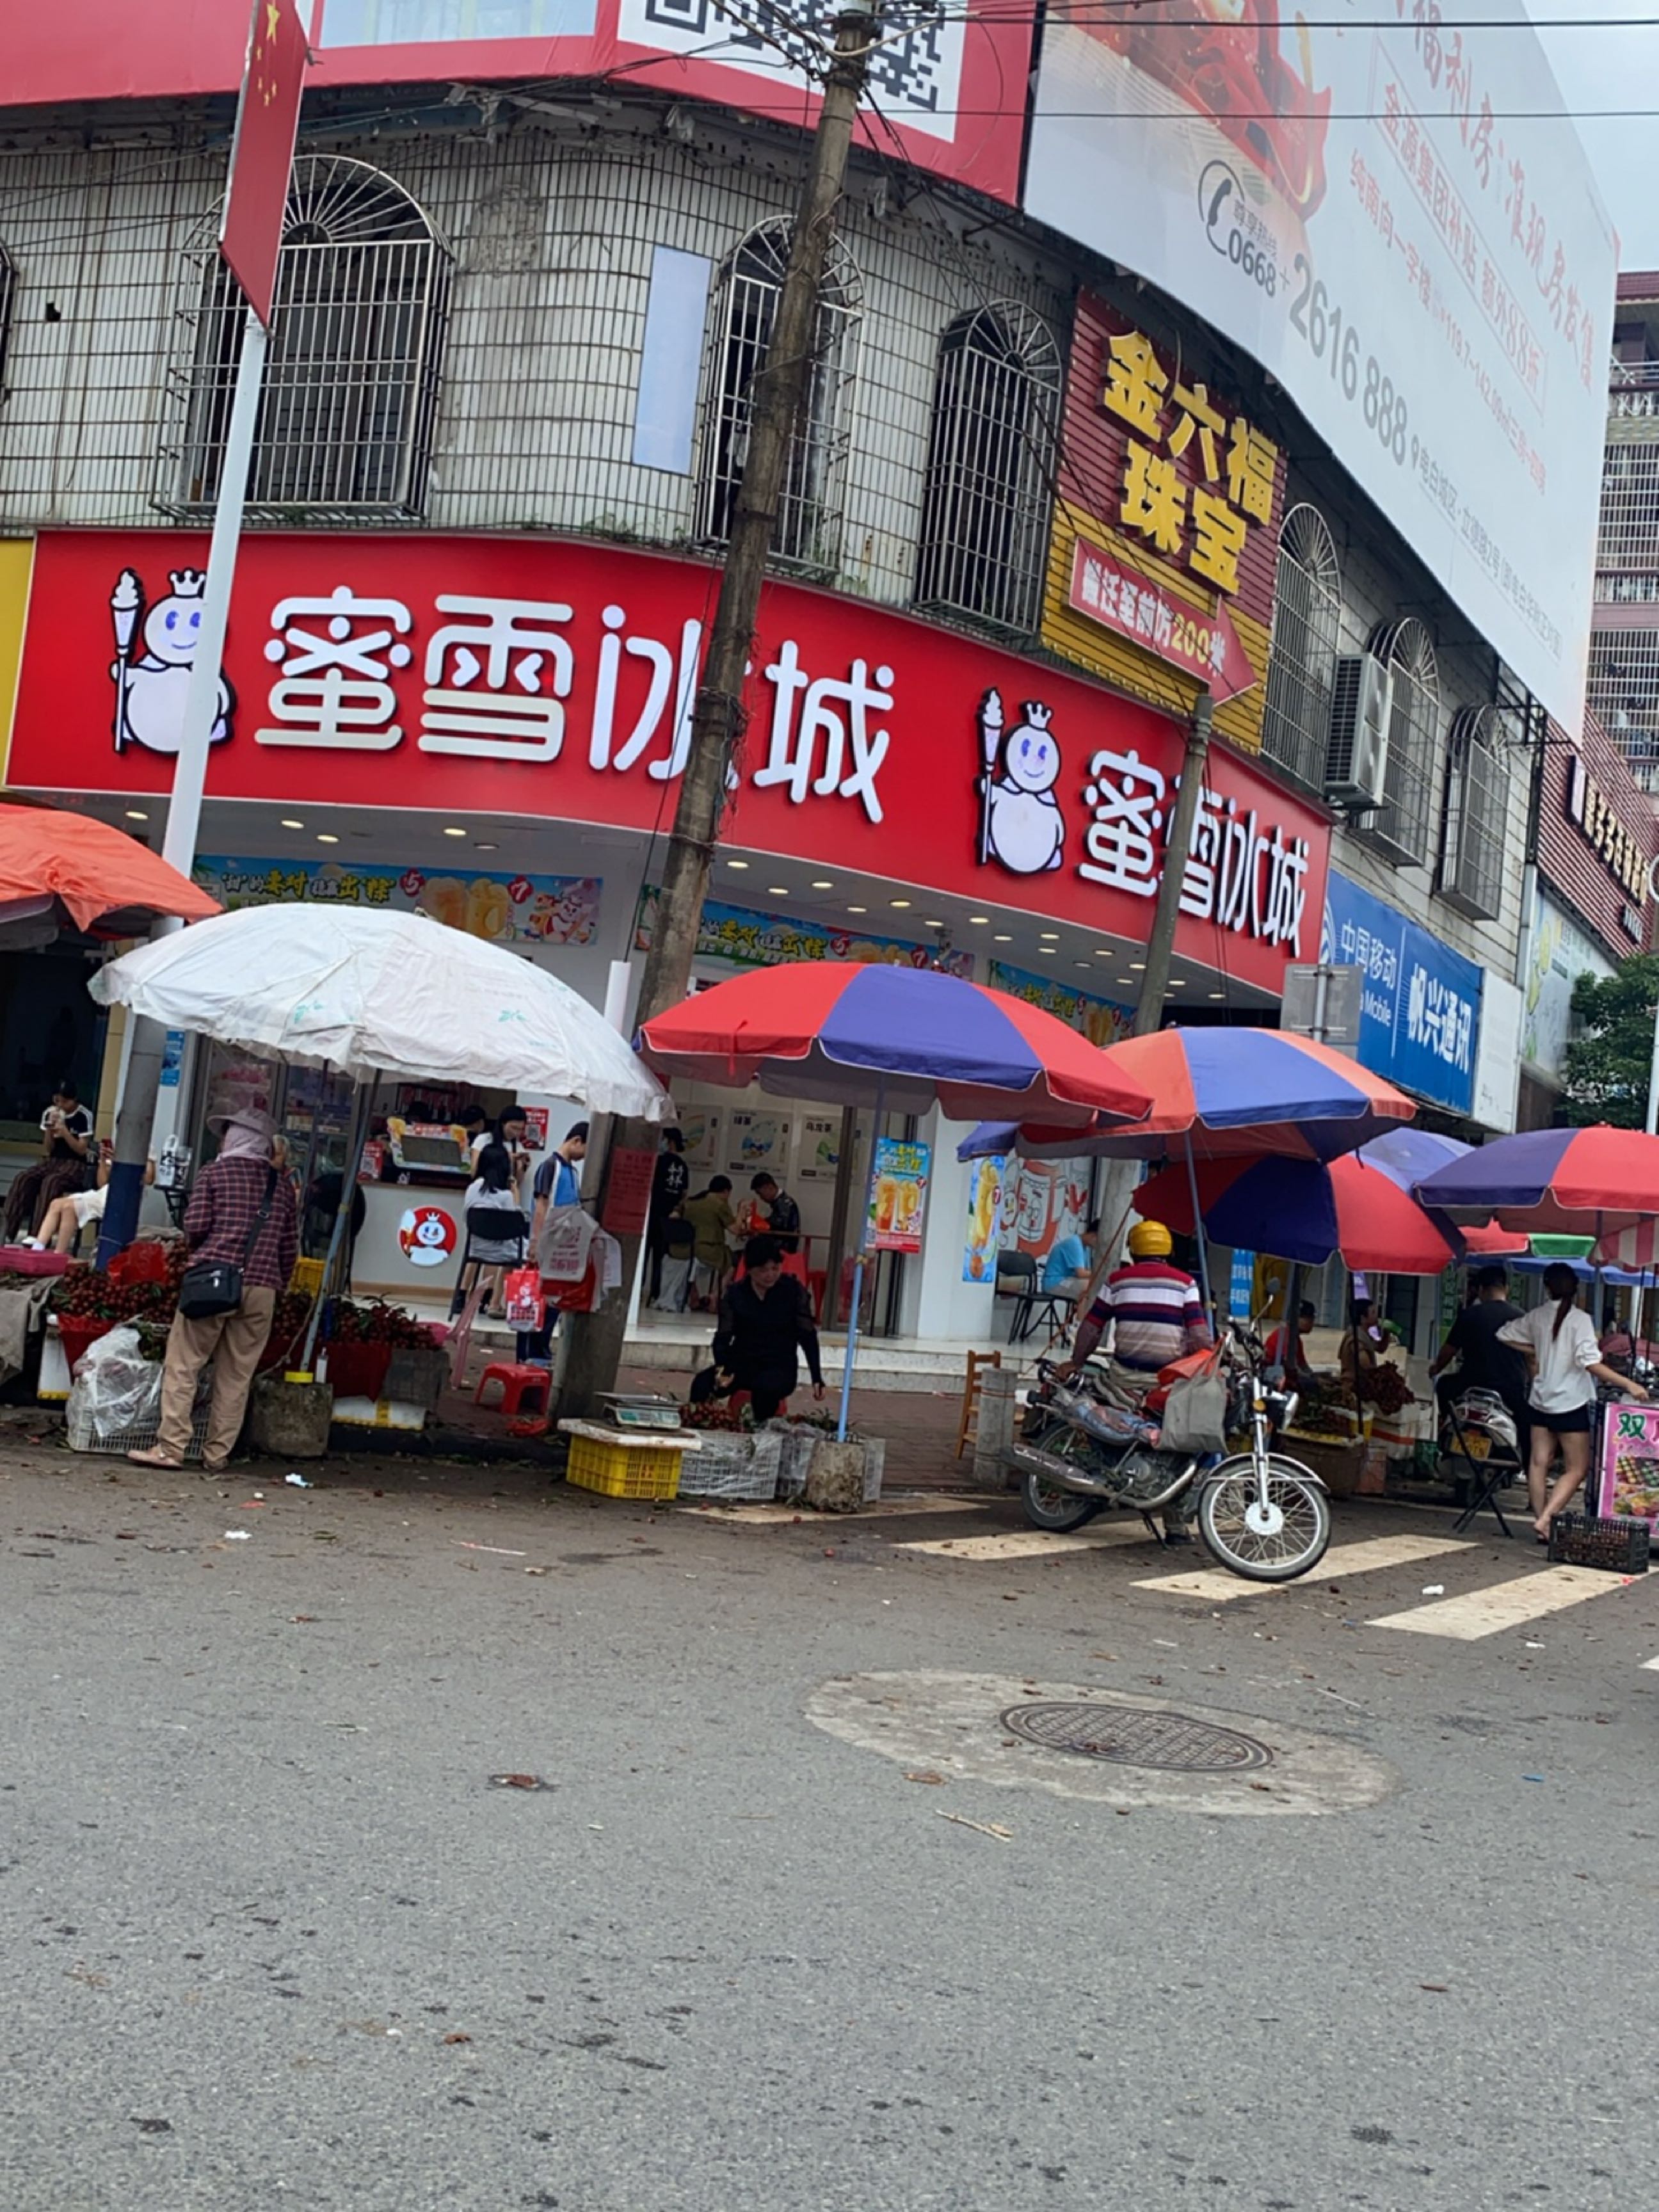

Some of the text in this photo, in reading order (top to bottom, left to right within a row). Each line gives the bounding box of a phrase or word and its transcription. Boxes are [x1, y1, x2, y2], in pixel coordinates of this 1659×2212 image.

[1102, 330, 1279, 527] 金六福
[1228, 228, 1408, 467] 0668 2616 888
[1120, 439, 1247, 597] 珠宝
[254, 585, 895, 825] 蜜雪冰城
[1342, 918, 1397, 990] 中国移动
